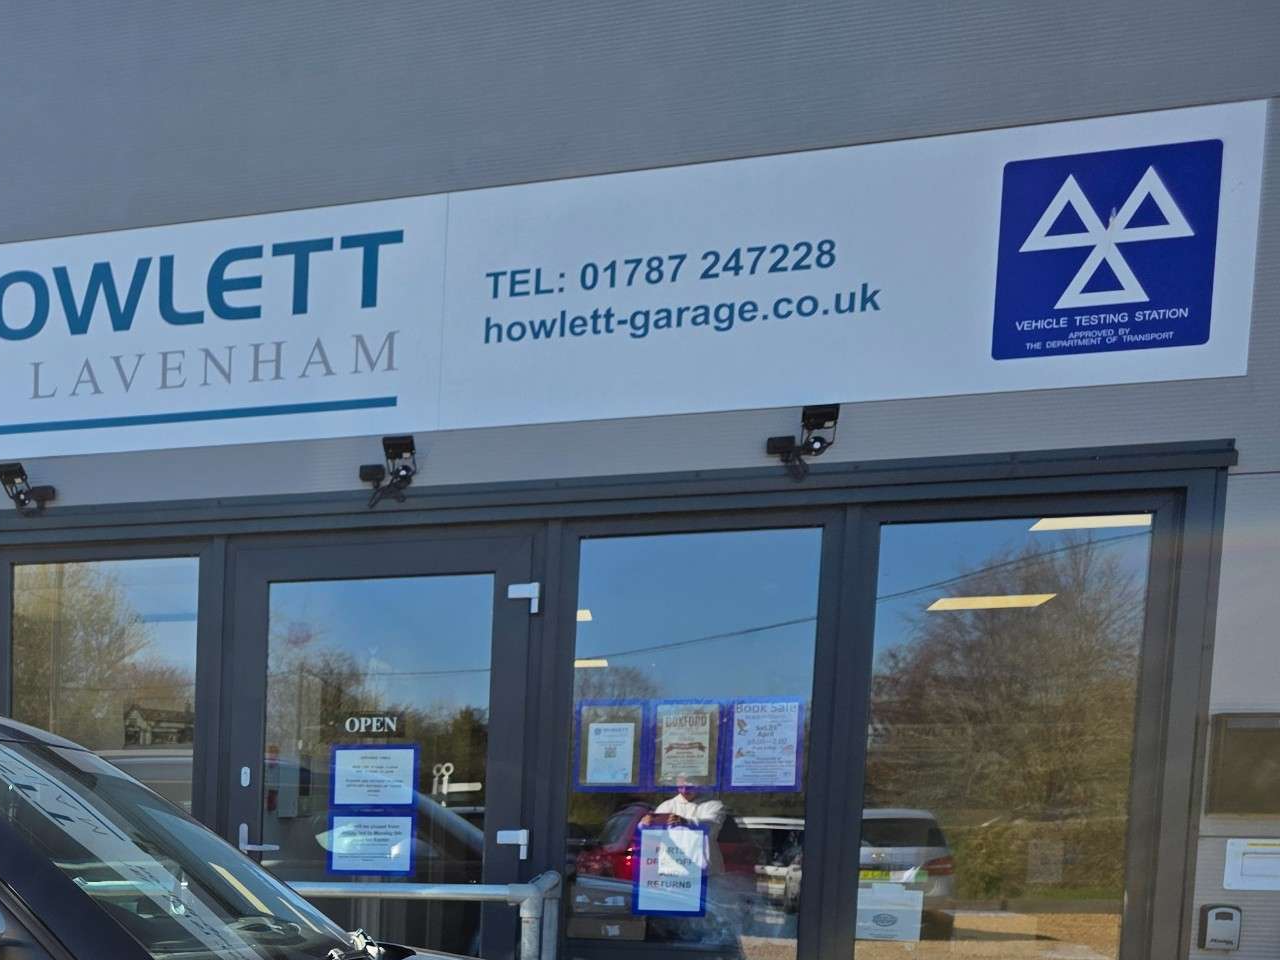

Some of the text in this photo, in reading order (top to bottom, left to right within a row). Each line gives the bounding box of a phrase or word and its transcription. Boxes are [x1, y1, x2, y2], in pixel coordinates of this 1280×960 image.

[485, 239, 836, 299] TEL: 01787 247228
[484, 283, 882, 344] howlett-garage.co.uk
[1015, 307, 1189, 331] VEHICLE TESTING STATION
[1026, 331, 1175, 351] THE DEPARTMENT OF TRANSPORT
[1068, 327, 1131, 340] APPROVED BY
[30, 330, 399, 400] LAVENHAM
[345, 717, 398, 733] OPEN
[647, 880, 692, 889] RETURNS
